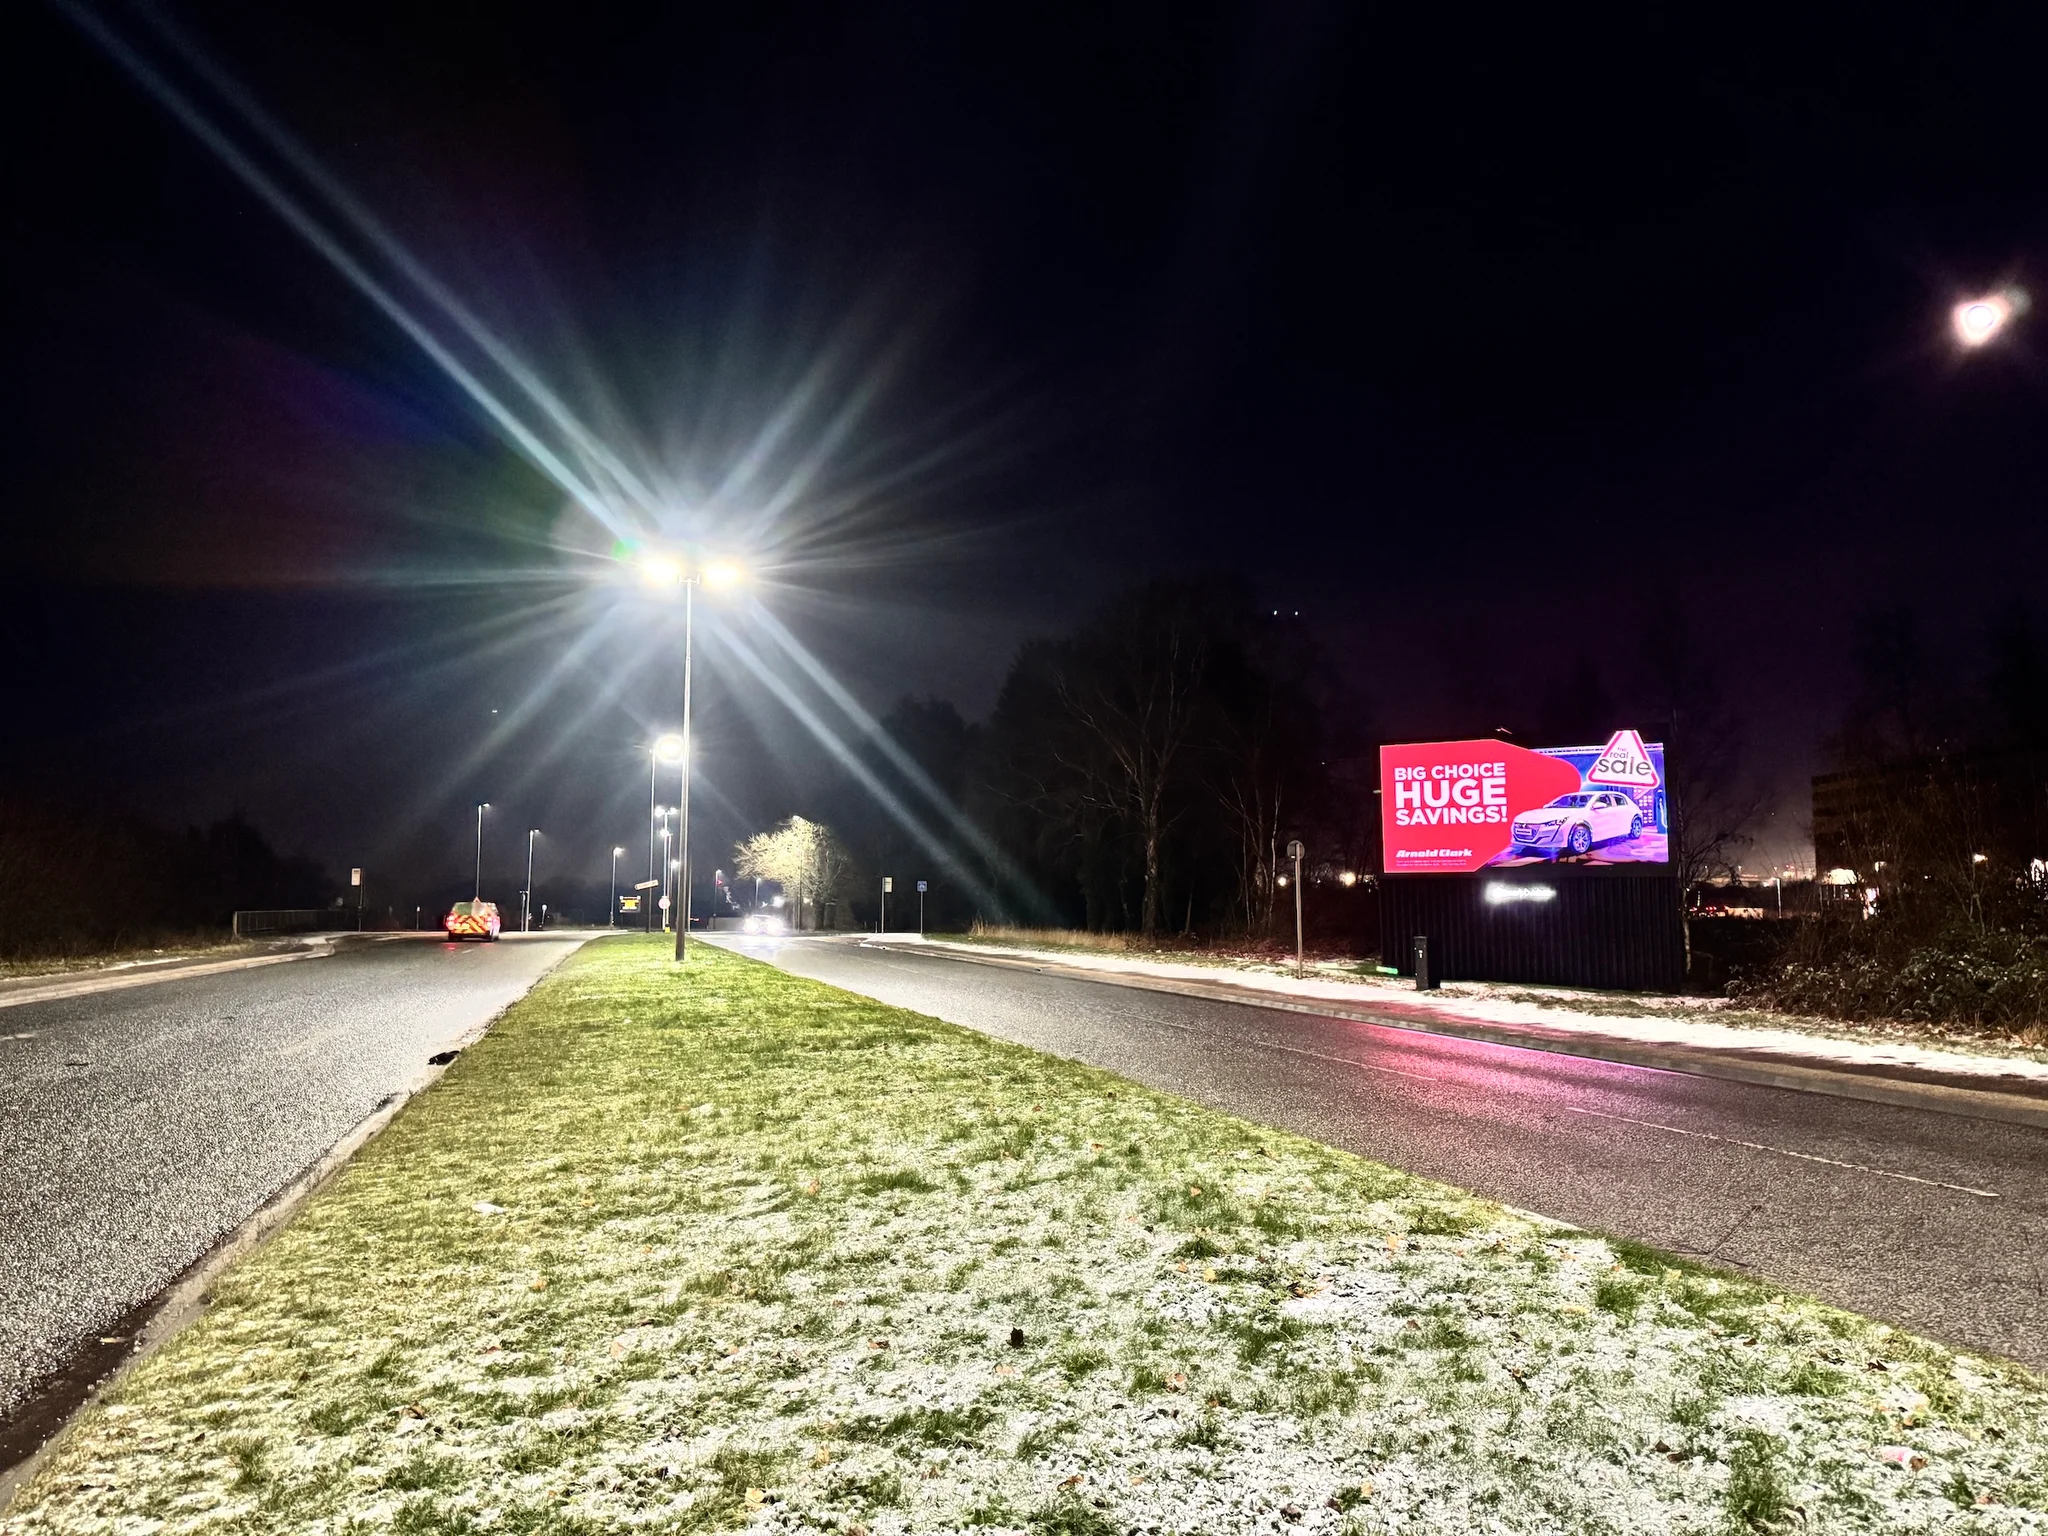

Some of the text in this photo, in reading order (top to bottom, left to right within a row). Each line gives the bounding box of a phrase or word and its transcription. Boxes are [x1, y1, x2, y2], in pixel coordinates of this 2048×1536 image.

[1610, 751, 1629, 759] real
[1395, 762, 1506, 780] BIG CHOICE
[1597, 756, 1651, 776] sale
[1395, 778, 1507, 808] HUGE
[1396, 806, 1508, 825] SAVINGS!
[1396, 848, 1472, 858] Arnold Clark
